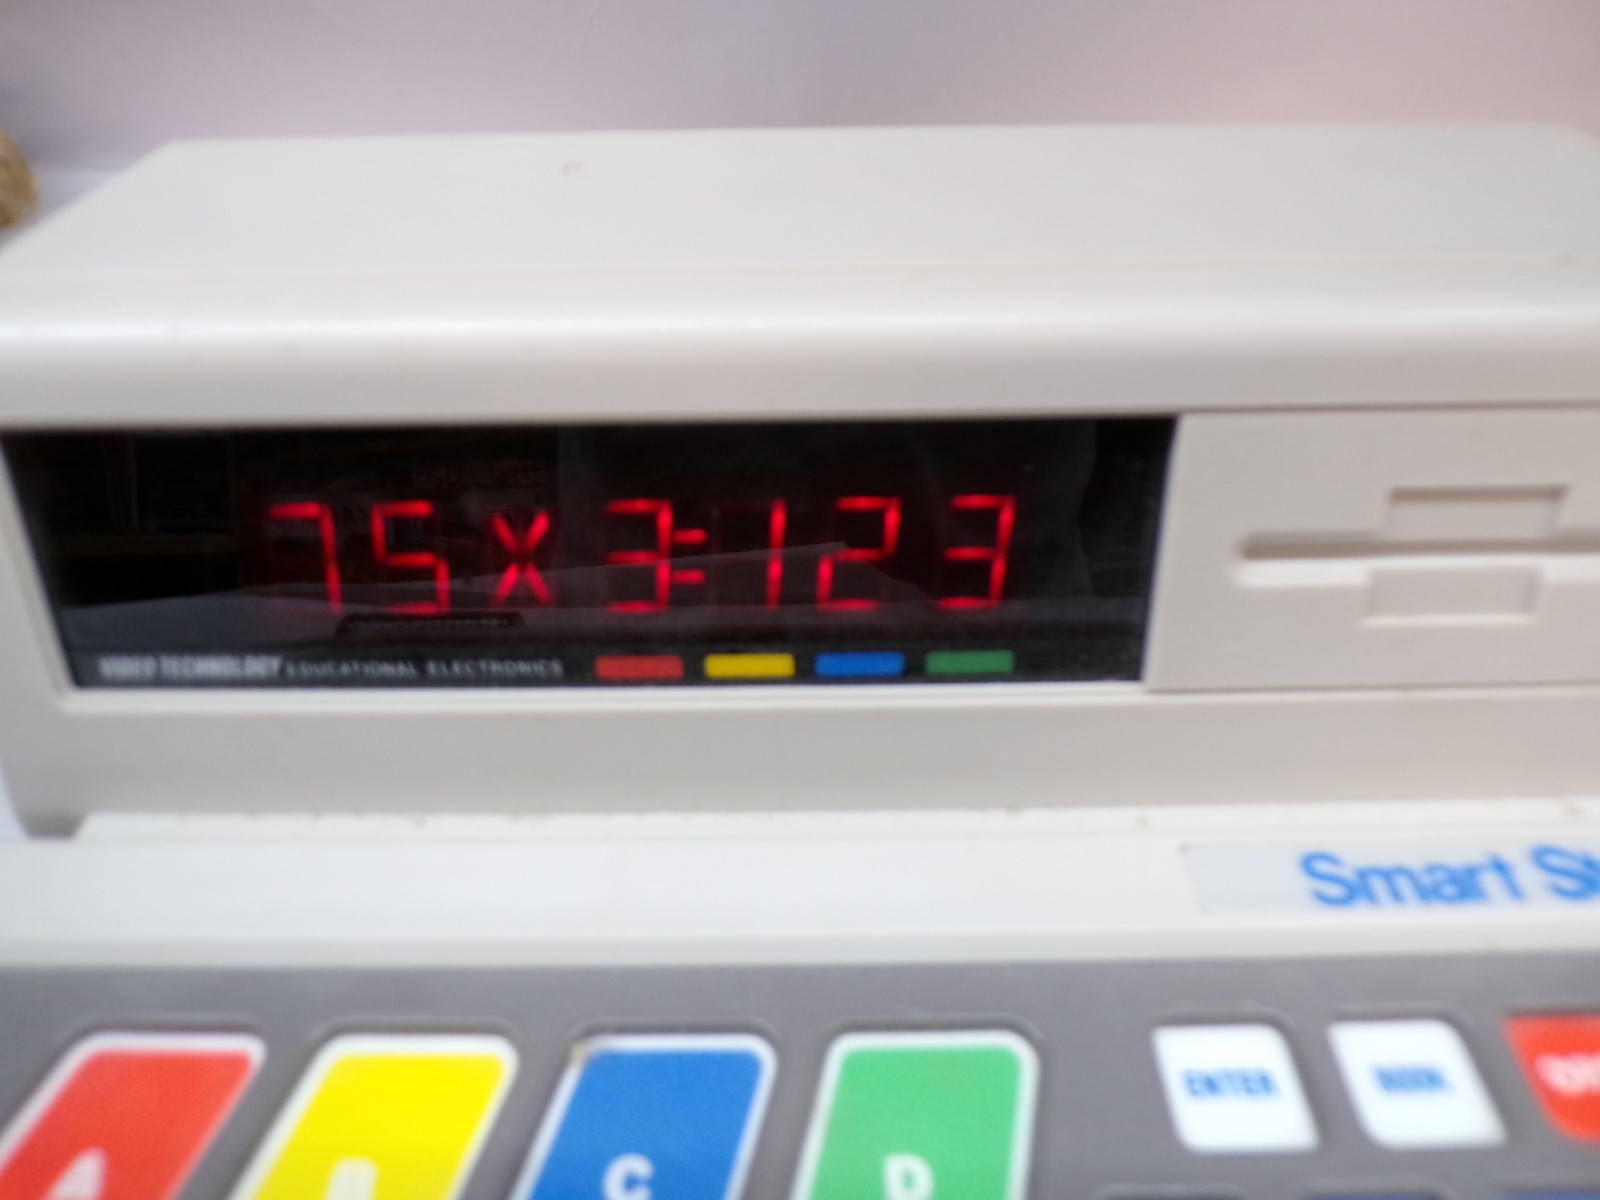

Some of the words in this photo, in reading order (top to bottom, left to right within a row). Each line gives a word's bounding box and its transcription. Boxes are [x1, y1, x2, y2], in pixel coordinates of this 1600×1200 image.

[268, 499, 450, 615] 75
[285, 660, 418, 678] EDUCATIONAL
[426, 660, 565, 678] ELECTRONICS
[1299, 850, 1526, 906] Smart
[1181, 1066, 1280, 1099] ENTER
[603, 1153, 654, 1200] C
[883, 1152, 934, 1200] D
